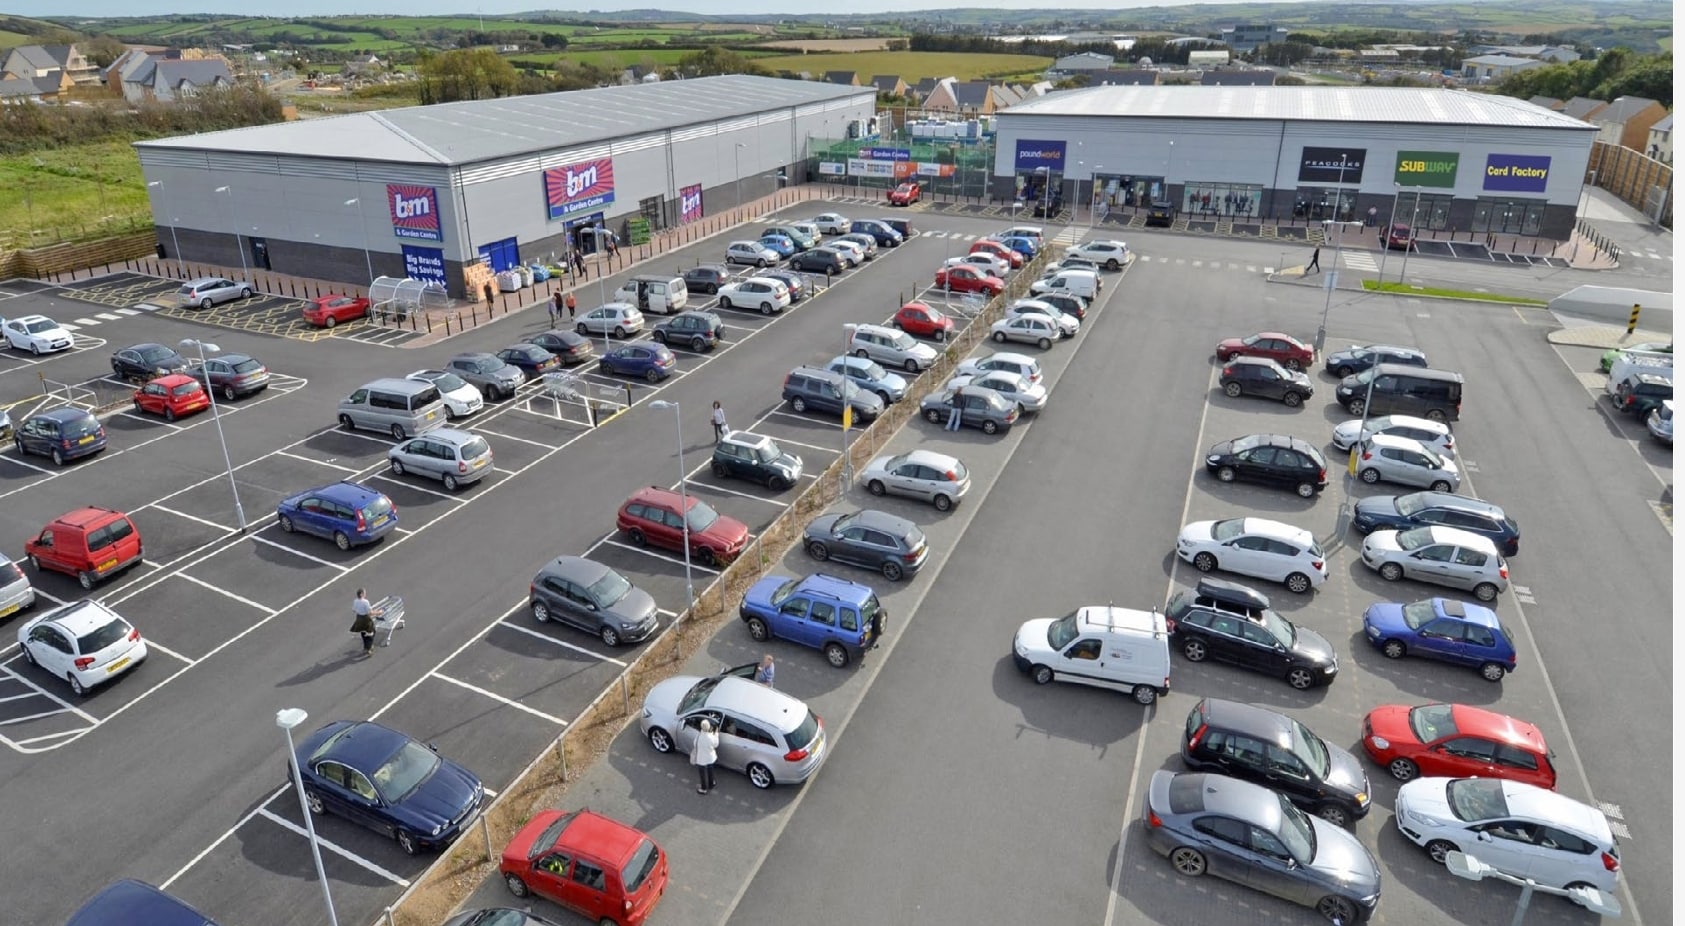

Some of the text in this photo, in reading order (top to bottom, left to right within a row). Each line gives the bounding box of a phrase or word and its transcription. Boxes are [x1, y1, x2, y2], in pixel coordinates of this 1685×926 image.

[1020, 150, 1061, 159] poundworld
[1399, 160, 1456, 173] SUBWAY
[1487, 166, 1547, 179] Card Factory
[569, 201, 587, 212] Garden
[587, 198, 604, 207] Centre
[401, 229, 419, 237] Garden
[420, 231, 437, 239] Centre
[406, 254, 441, 266] Big Brands
[406, 263, 444, 277] Big Savings
